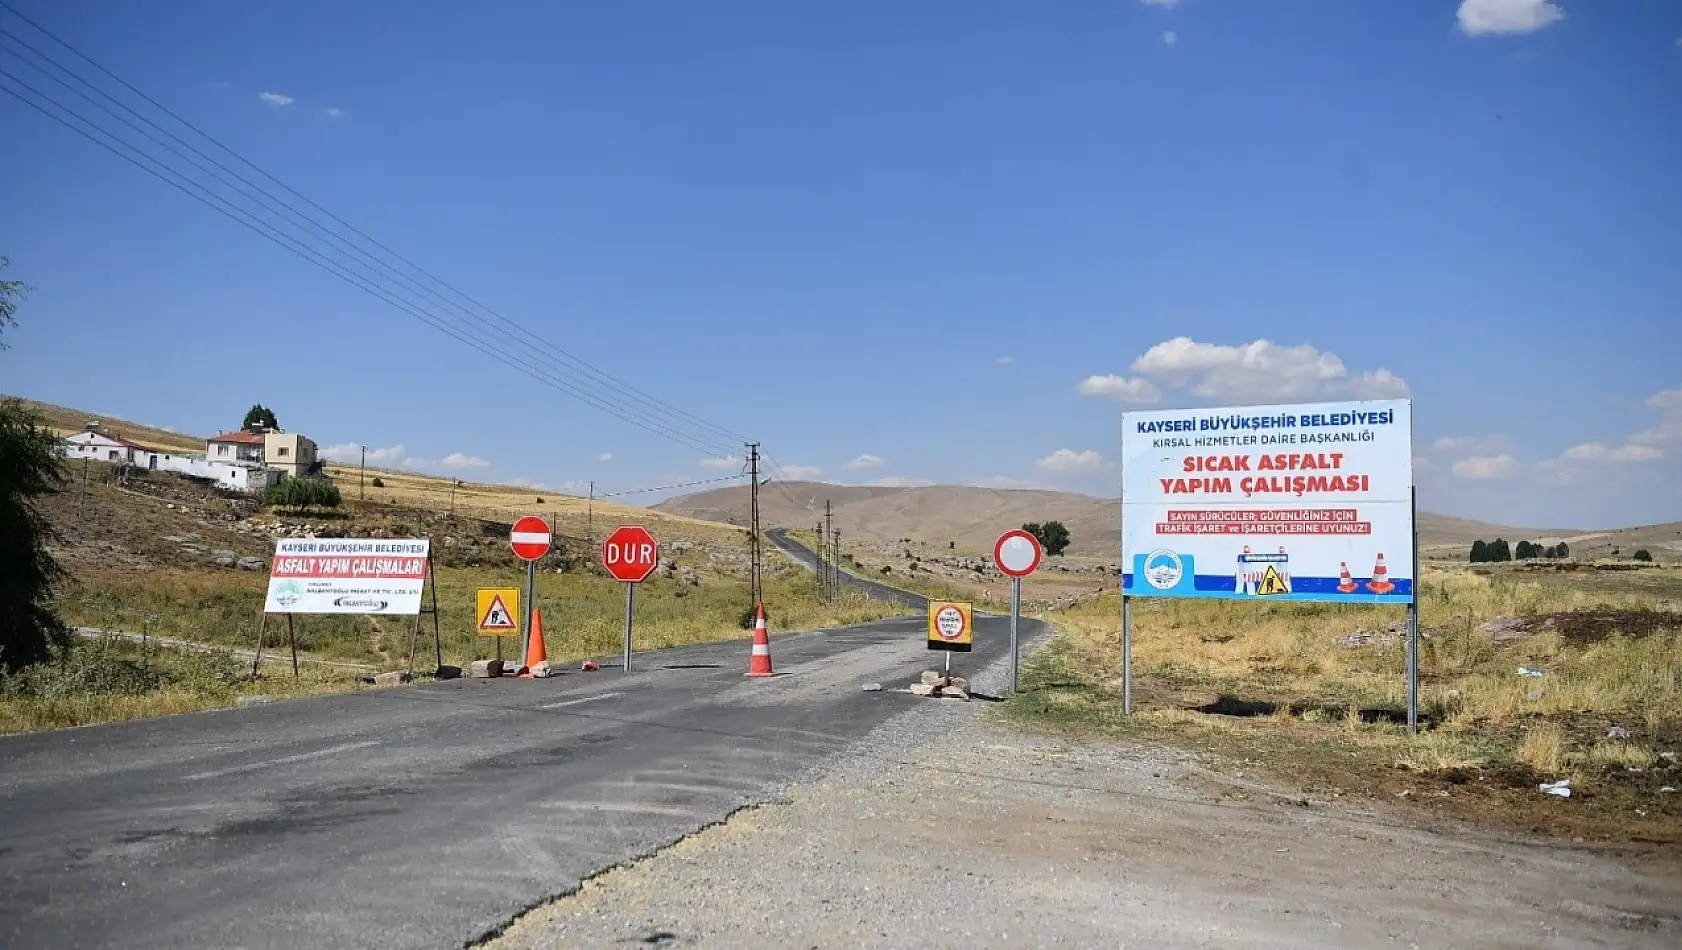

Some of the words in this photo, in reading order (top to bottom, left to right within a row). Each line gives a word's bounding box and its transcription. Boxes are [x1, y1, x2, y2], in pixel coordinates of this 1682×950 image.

[1137, 416, 1196, 434] KAYSERİ
[1200, 413, 1297, 431] BÜYÜKŞEHİR
[1300, 408, 1393, 427] BELEDİYESİ
[1153, 438, 1191, 448] KIRSAL
[1195, 435, 1257, 447] HİZMETLER
[1261, 432, 1297, 445] DAİRE
[1300, 429, 1375, 445] BAŞKANLIĞI
[1183, 455, 1251, 473] SICAK
[1257, 453, 1343, 471] ASFALT
[1160, 477, 1232, 494] YAPIM
[1240, 475, 1369, 497] ÇALIŞMASI
[1170, 512, 1197, 521] SAYIN
[1260, 509, 1330, 521] GÜVENLİĞİNİZ
[1333, 509, 1353, 521] İÇİN
[1159, 523, 1191, 533] TRAFİK
[1194, 522, 1226, 534] İŞARET
[1228, 525, 1240, 533] ve
[1241, 522, 1319, 534] İŞARETÇİLERİNE
[1322, 523, 1368, 533] UYUNUZ!
[282, 542, 317, 552] KAYSERİ
[318, 542, 373, 554] BÜYÜKŞEHİR
[375, 543, 425, 553] BELEDİYESİ
[608, 543, 652, 564] DUR
[275, 558, 316, 574] ASFALT
[318, 558, 350, 574] YAPIM
[353, 558, 423, 577] ÇALIŞMALARI
